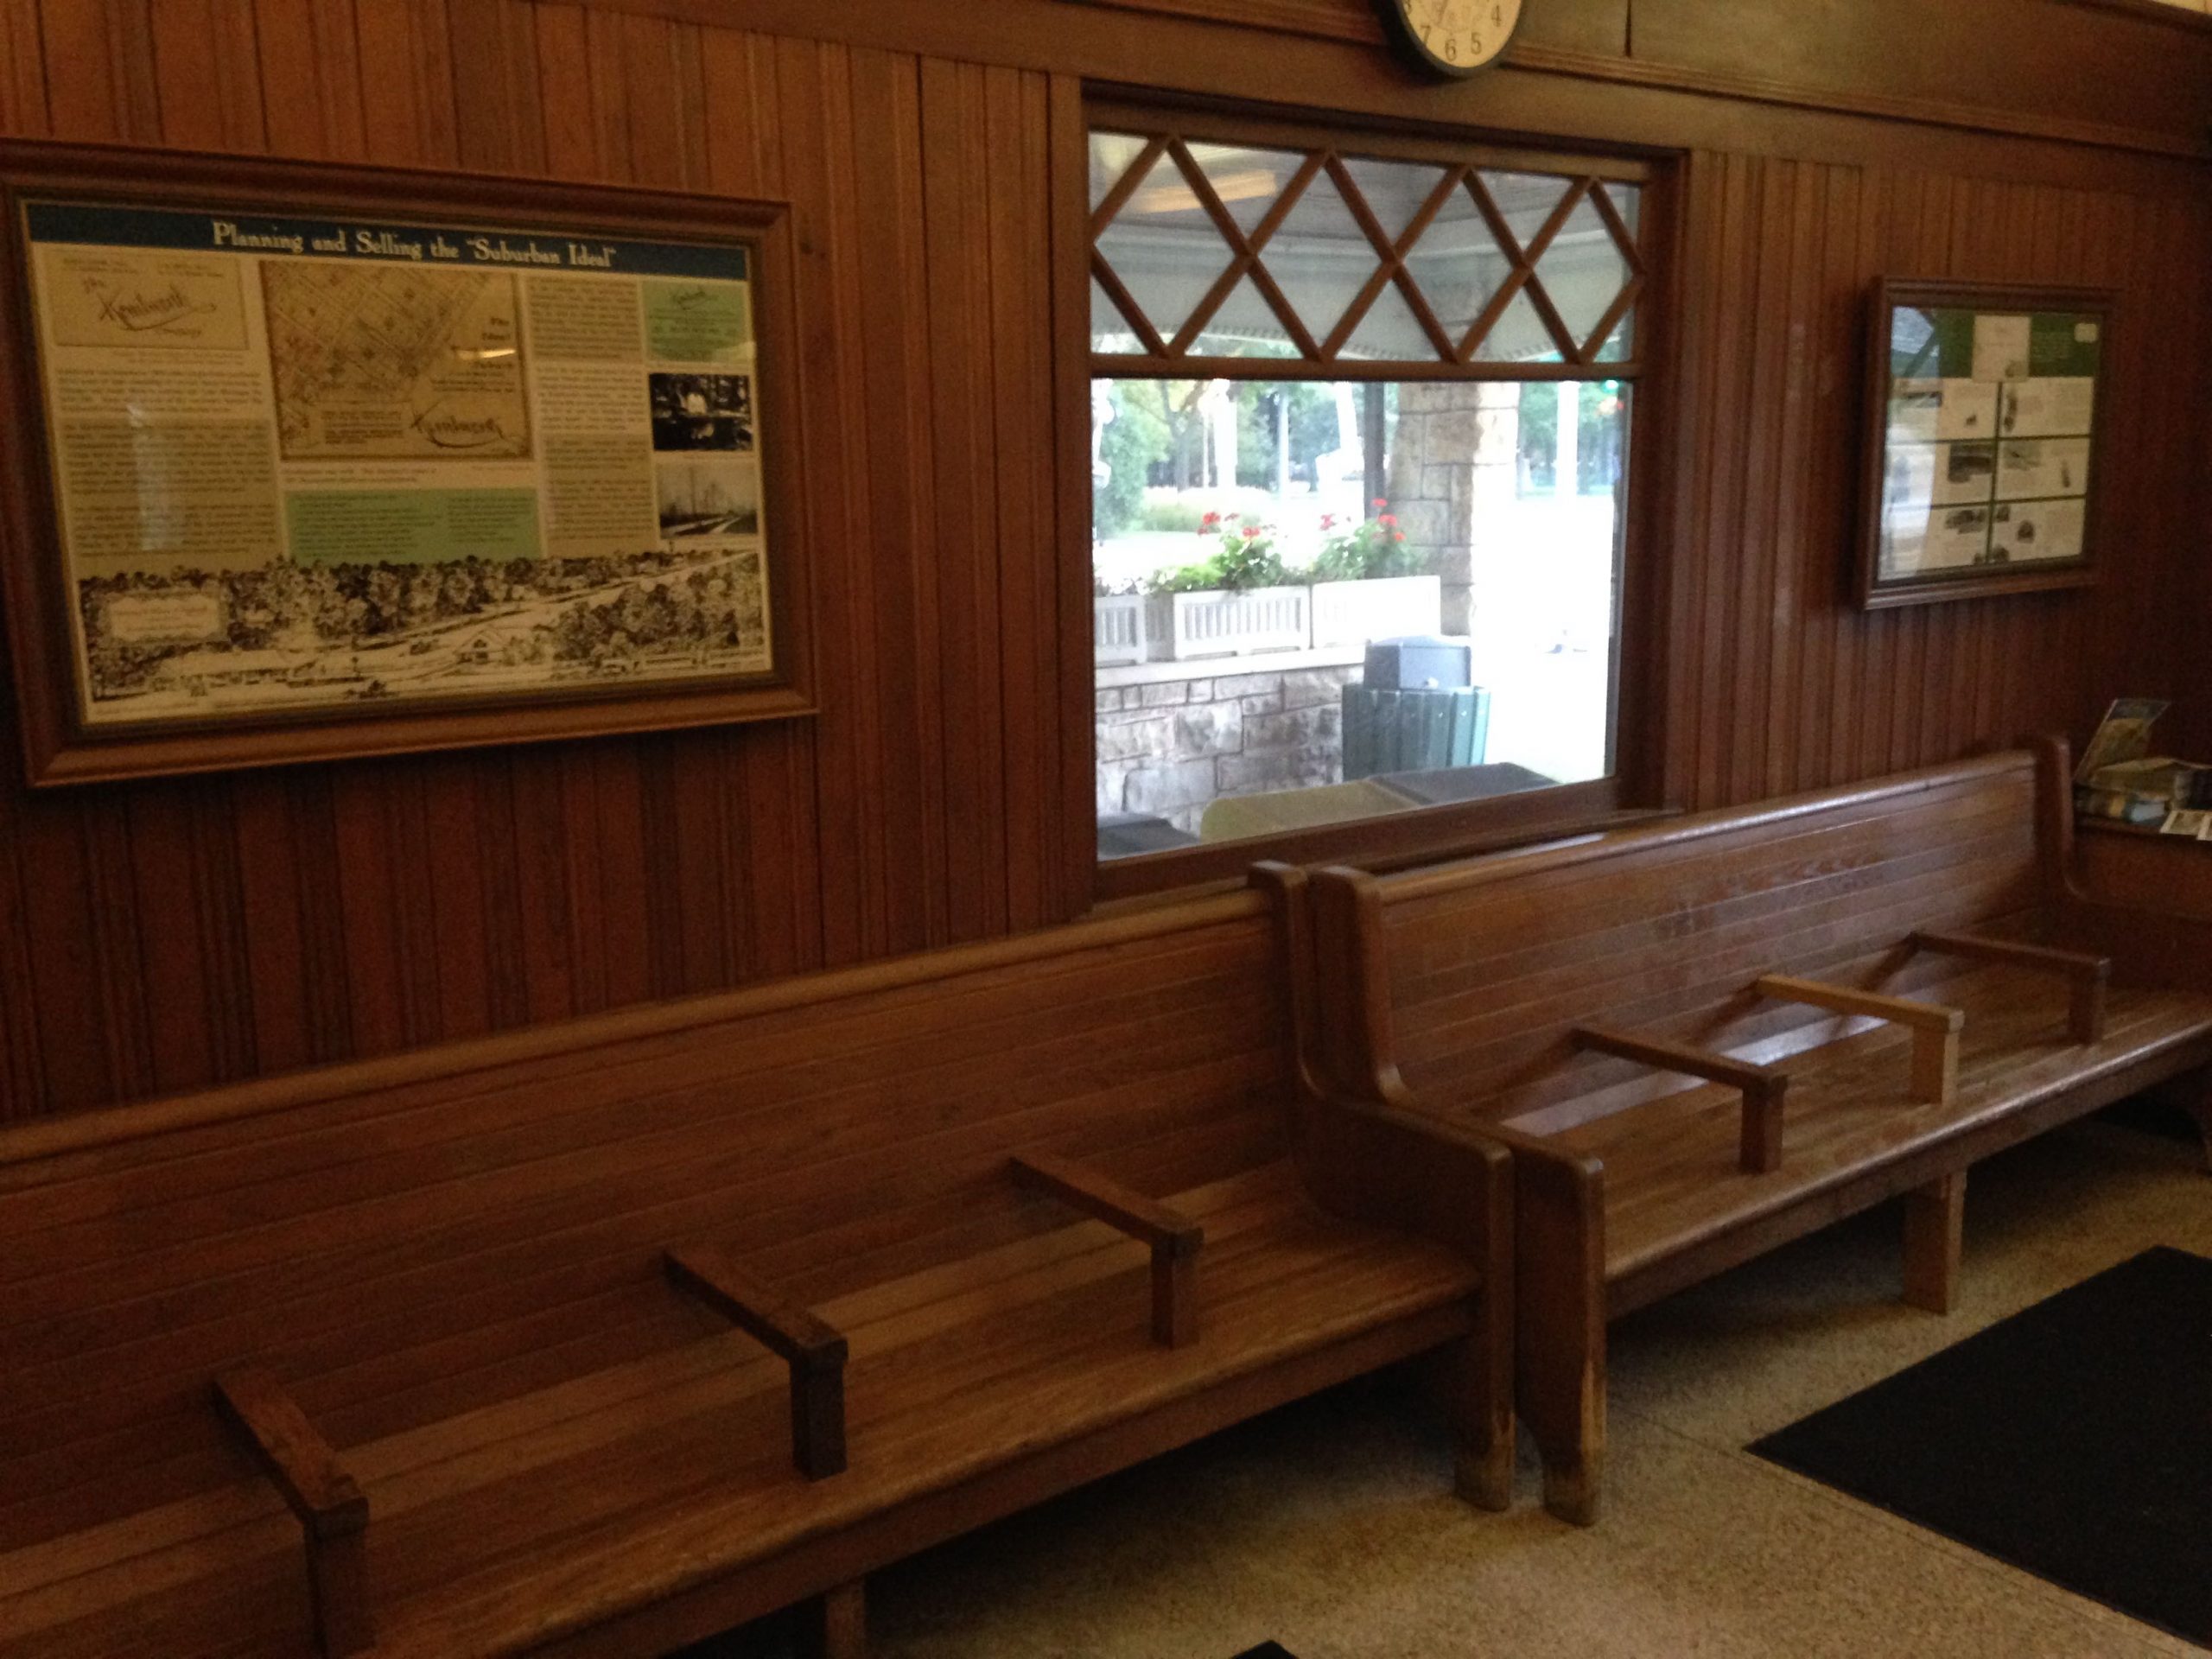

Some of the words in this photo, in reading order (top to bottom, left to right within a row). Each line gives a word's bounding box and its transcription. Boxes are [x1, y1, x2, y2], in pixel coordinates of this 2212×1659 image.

[1491, 4, 1502, 28] 4
[1420, 24, 1431, 44] 7
[1471, 32, 1482, 54] 5
[1445, 39, 1457, 61] 6
[213, 221, 303, 254] Planning
[311, 229, 347, 252] and
[356, 230, 423, 259] Selling
[430, 235, 460, 257] the
